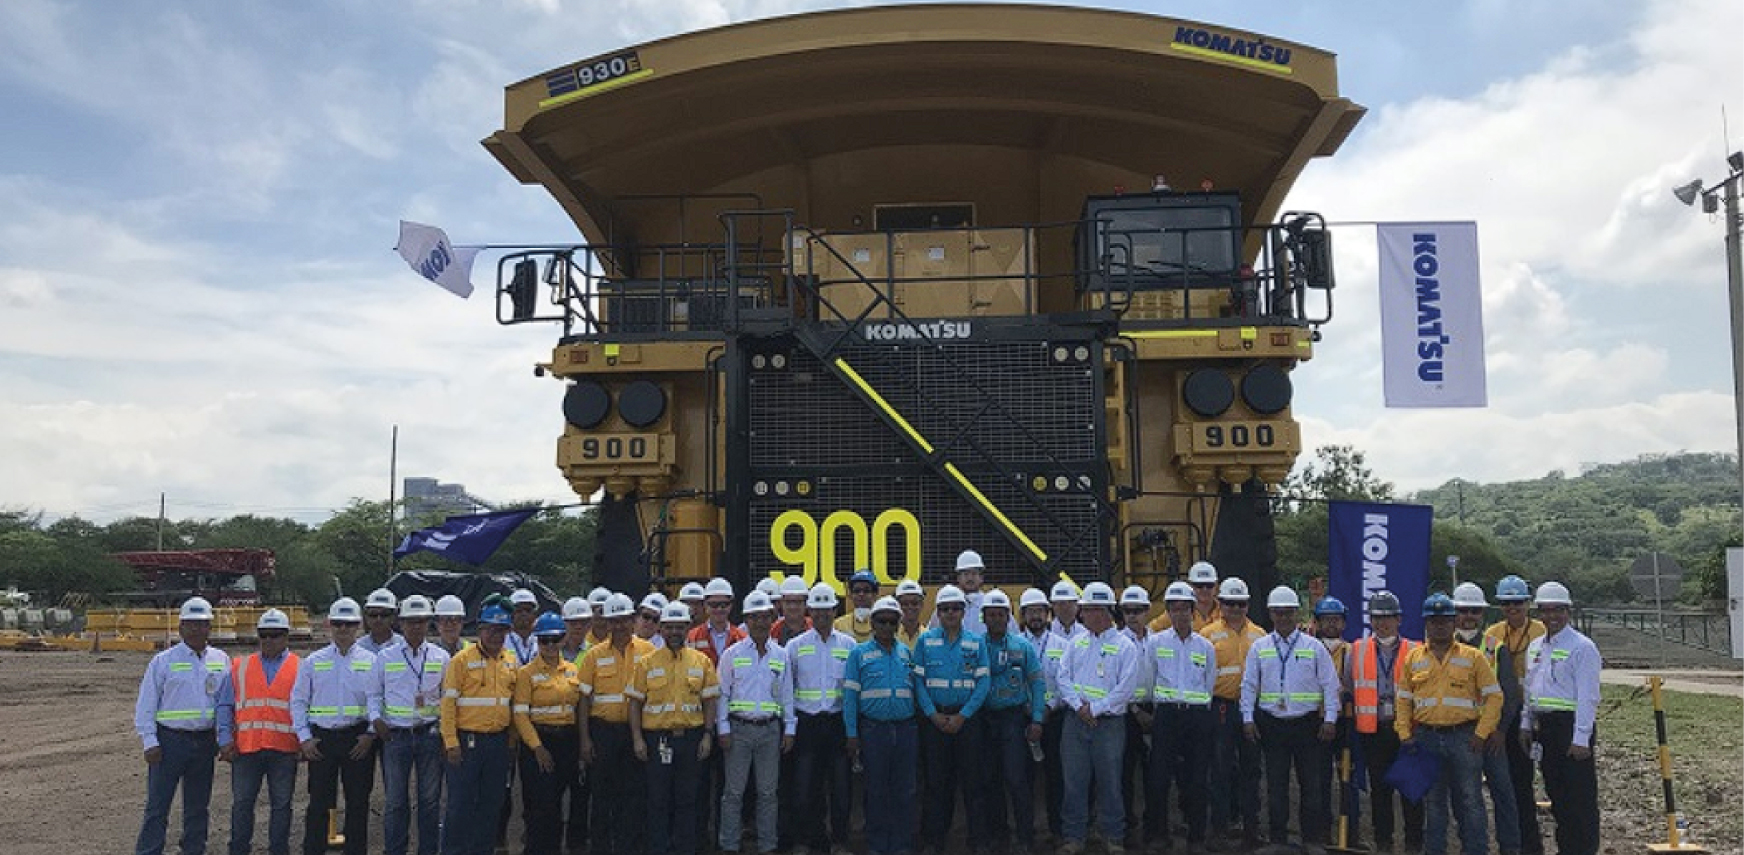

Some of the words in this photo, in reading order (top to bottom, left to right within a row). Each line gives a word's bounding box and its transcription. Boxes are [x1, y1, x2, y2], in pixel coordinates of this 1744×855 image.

[1174, 26, 1291, 64] KOMATSU
[1413, 233, 1450, 381] KOMATSU
[865, 320, 972, 340] KOMATSU
[583, 437, 646, 458] 900
[1205, 423, 1274, 447] 900
[769, 508, 923, 596] 900
[1362, 512, 1389, 639] KOM
